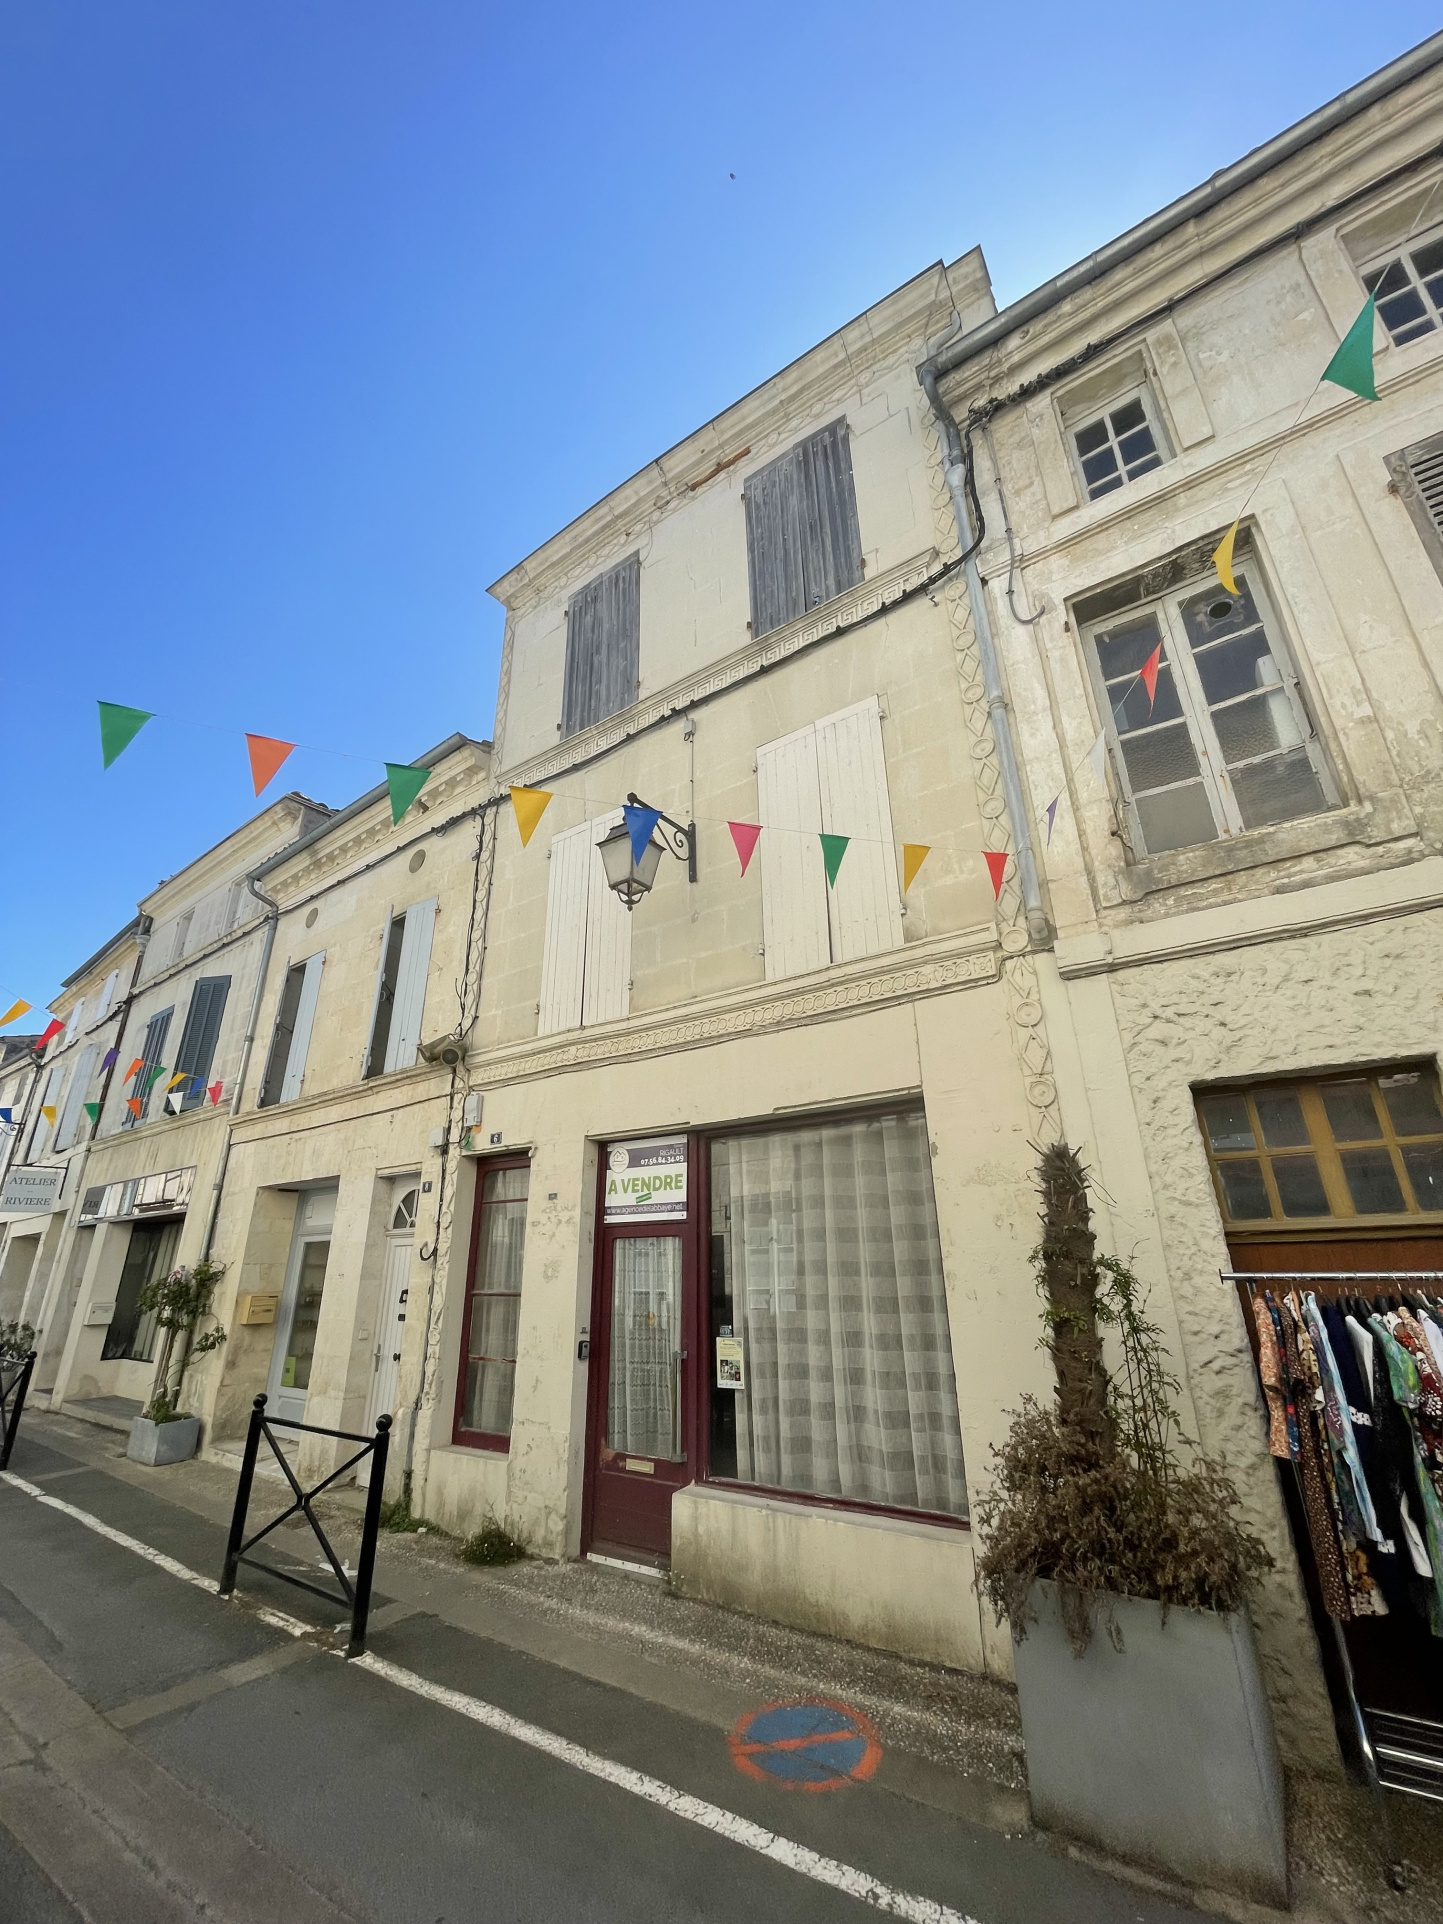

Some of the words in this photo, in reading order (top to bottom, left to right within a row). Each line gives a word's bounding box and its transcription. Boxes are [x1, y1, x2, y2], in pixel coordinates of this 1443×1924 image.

[659, 1147, 684, 1156] RIGAULT
[9, 1177, 57, 1187] ATELIER
[607, 1179, 618, 1195] A
[621, 1173, 684, 1194] VENDRE
[4, 1196, 51, 1206] RIVIERE
